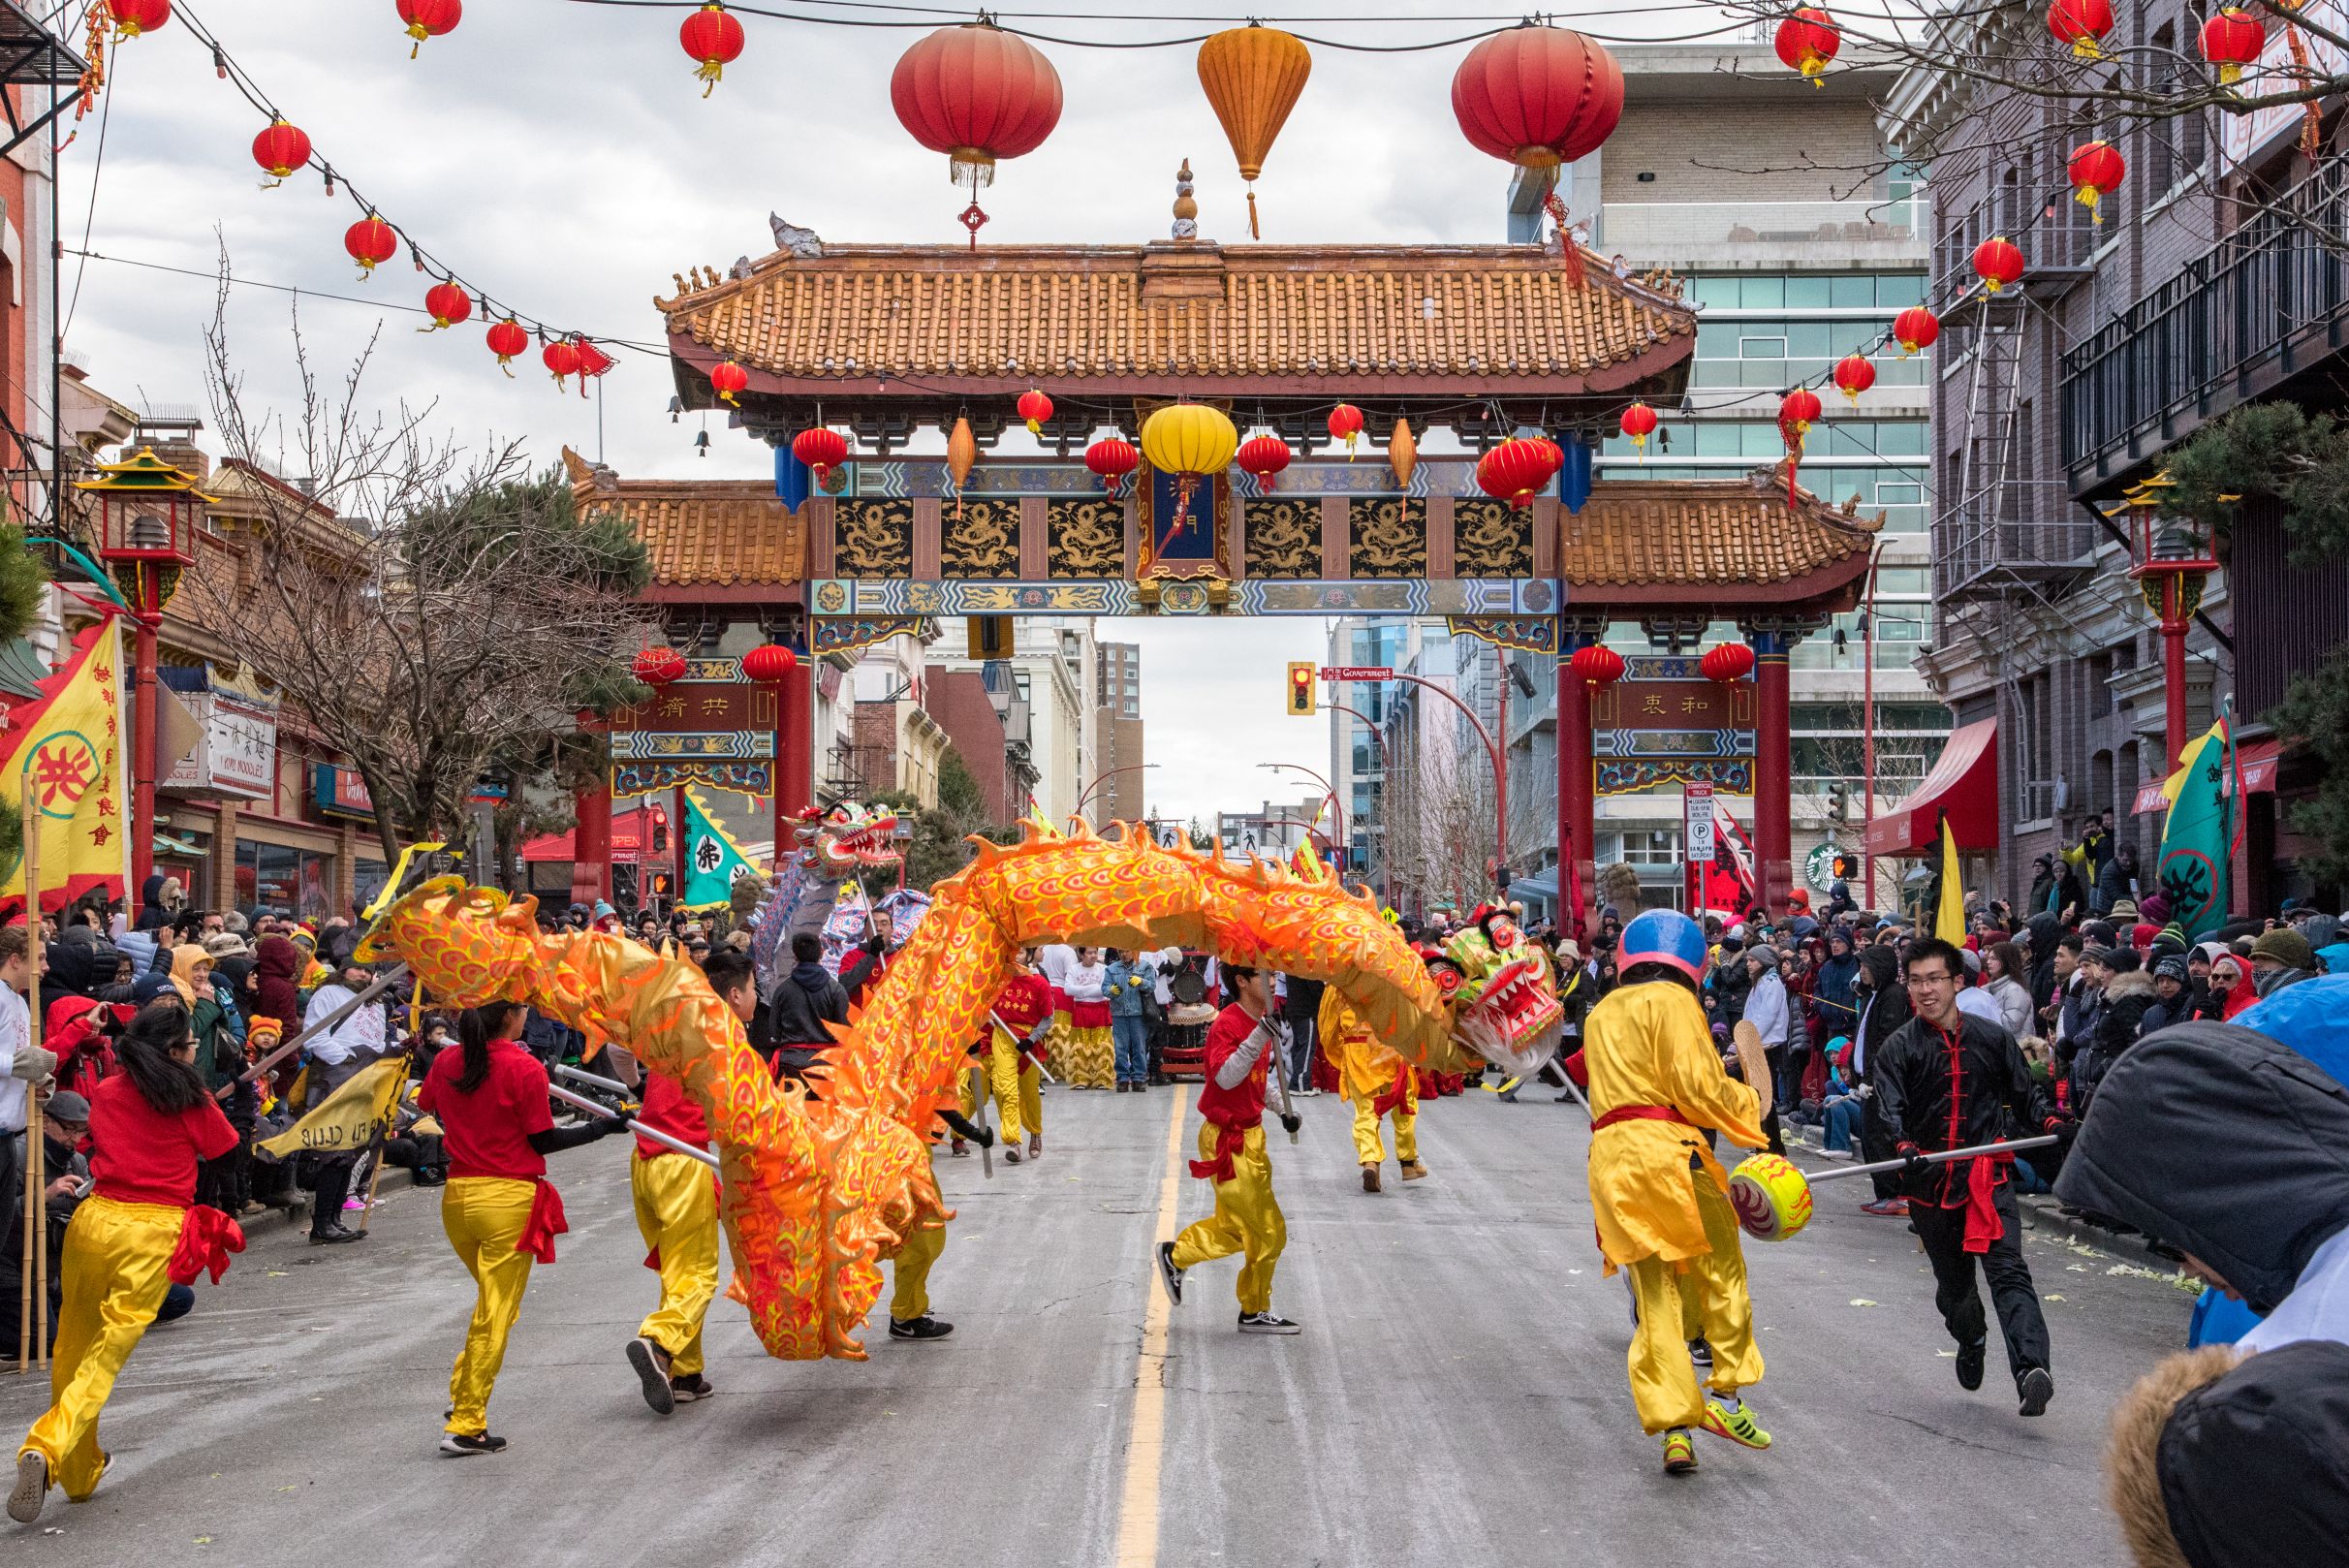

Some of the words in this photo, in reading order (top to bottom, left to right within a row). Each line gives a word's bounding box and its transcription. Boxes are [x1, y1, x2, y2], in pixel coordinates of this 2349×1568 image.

[1342, 668, 1391, 677] Government
[237, 760, 265, 779] NOODLES
[1698, 826, 1706, 835] P
[697, 835, 721, 870] 佛
